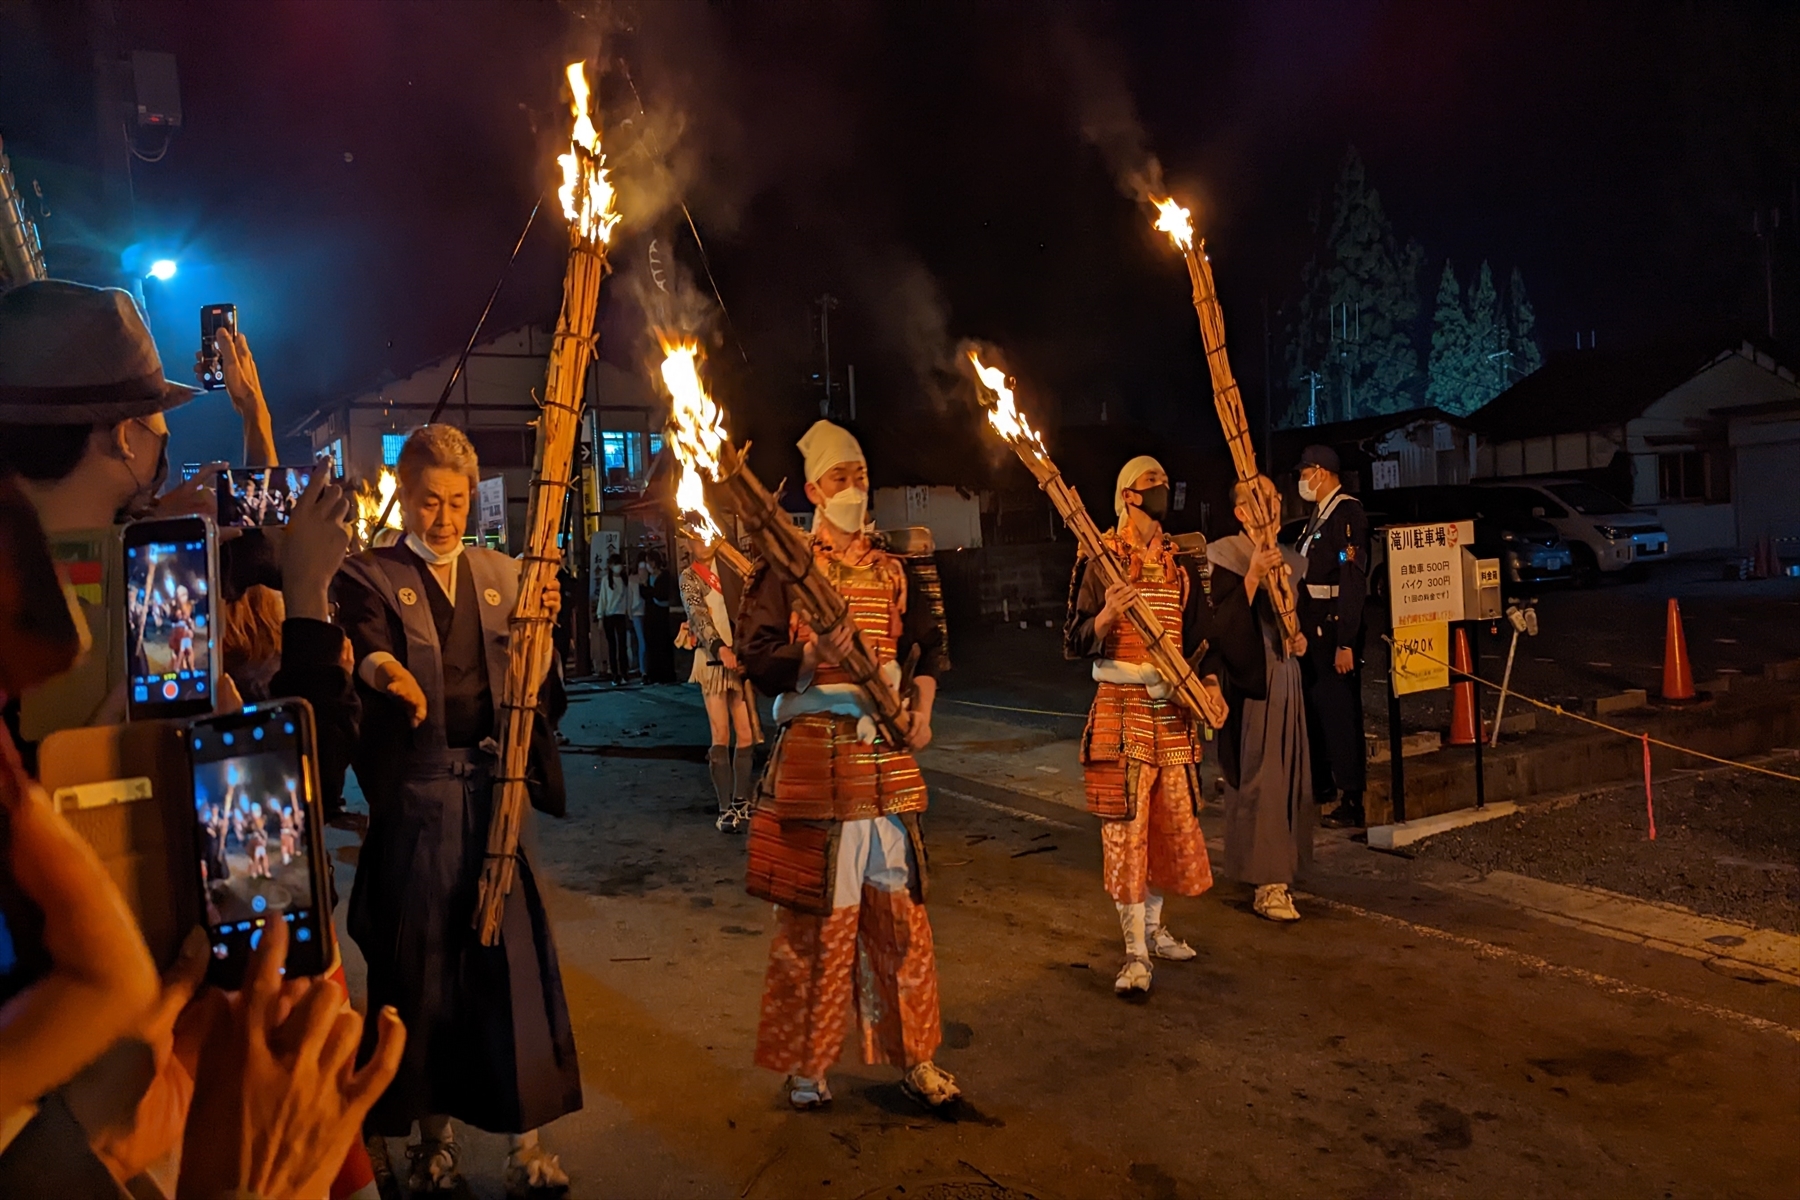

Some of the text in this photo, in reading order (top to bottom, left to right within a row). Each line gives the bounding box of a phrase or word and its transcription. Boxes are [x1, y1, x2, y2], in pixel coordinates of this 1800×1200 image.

[1391, 526, 1446, 551] 滝川駐車場
[1401, 561, 1450, 576] 自動車 500円
[1402, 575, 1451, 590] バイク 300円
